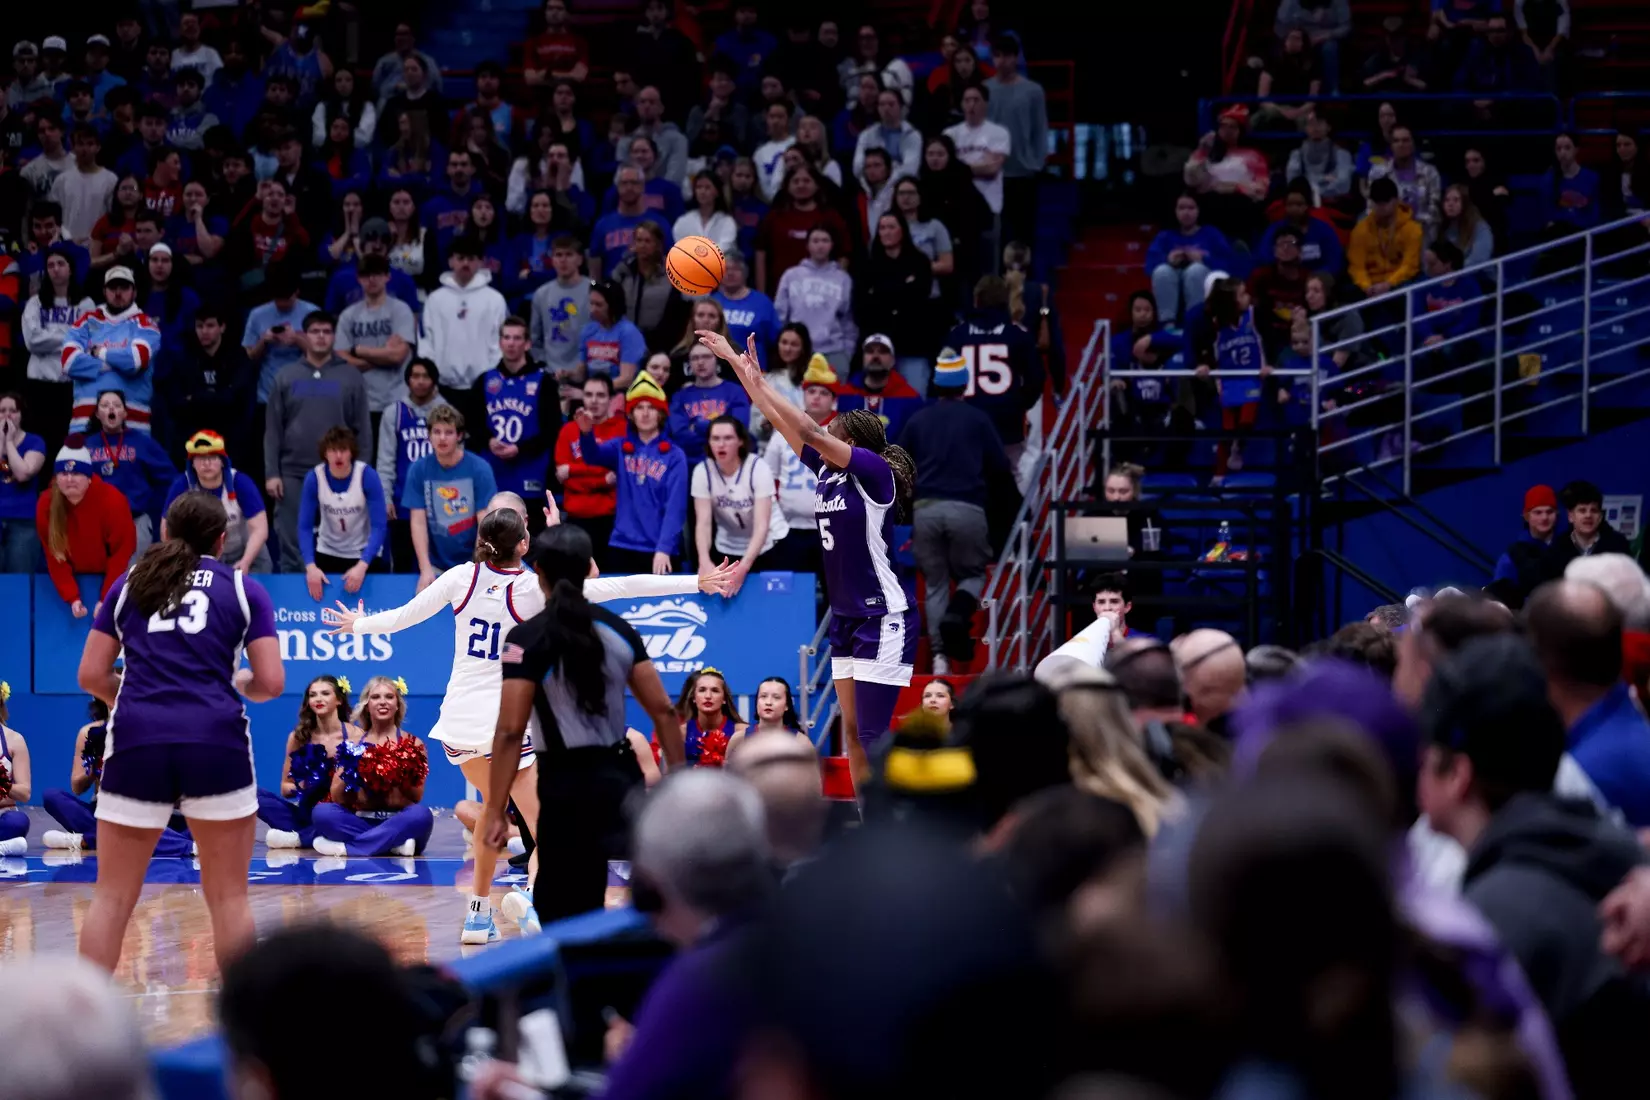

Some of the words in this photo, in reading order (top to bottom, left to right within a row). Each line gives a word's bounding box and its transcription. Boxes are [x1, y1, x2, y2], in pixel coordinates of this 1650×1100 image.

[960, 344, 1013, 397] 15
[491, 414, 523, 443] 30
[340, 518, 346, 532] 1
[735, 512, 746, 530] 1
[819, 518, 835, 552] 5
[147, 589, 210, 635] 23
[467, 617, 501, 660] 21
